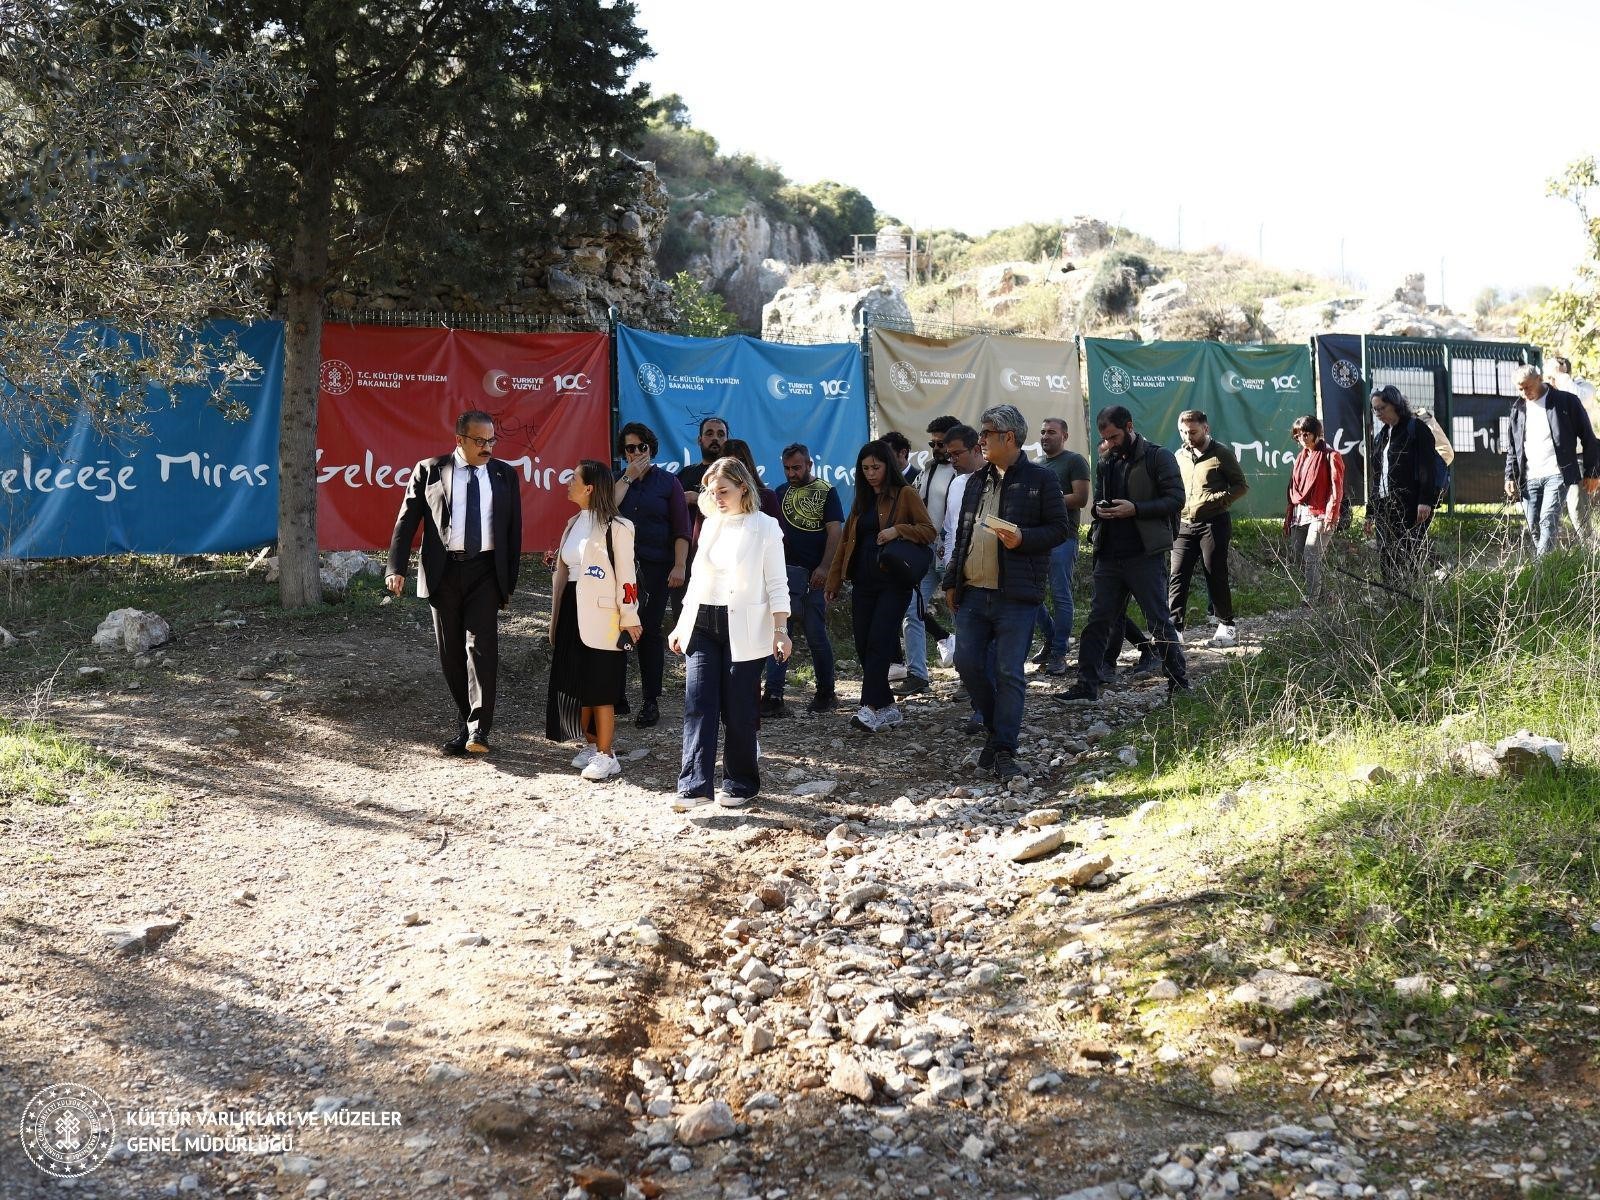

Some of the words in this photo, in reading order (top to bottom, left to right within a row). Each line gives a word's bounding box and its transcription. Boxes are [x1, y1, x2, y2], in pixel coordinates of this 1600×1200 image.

[357, 371, 371, 379] T.C.
[372, 371, 404, 380] KÜLTÜR
[417, 373, 448, 382] TURİZM
[667, 374, 680, 382] T.C.
[679, 374, 705, 384] KÜLTÜR
[705, 376, 714, 384] VE
[715, 376, 740, 385] TURİZM
[357, 379, 401, 388] BAKANLIĞI
[1231, 440, 1296, 469] Mira
[0, 452, 137, 502] eleceğe
[156, 451, 270, 488] Miras
